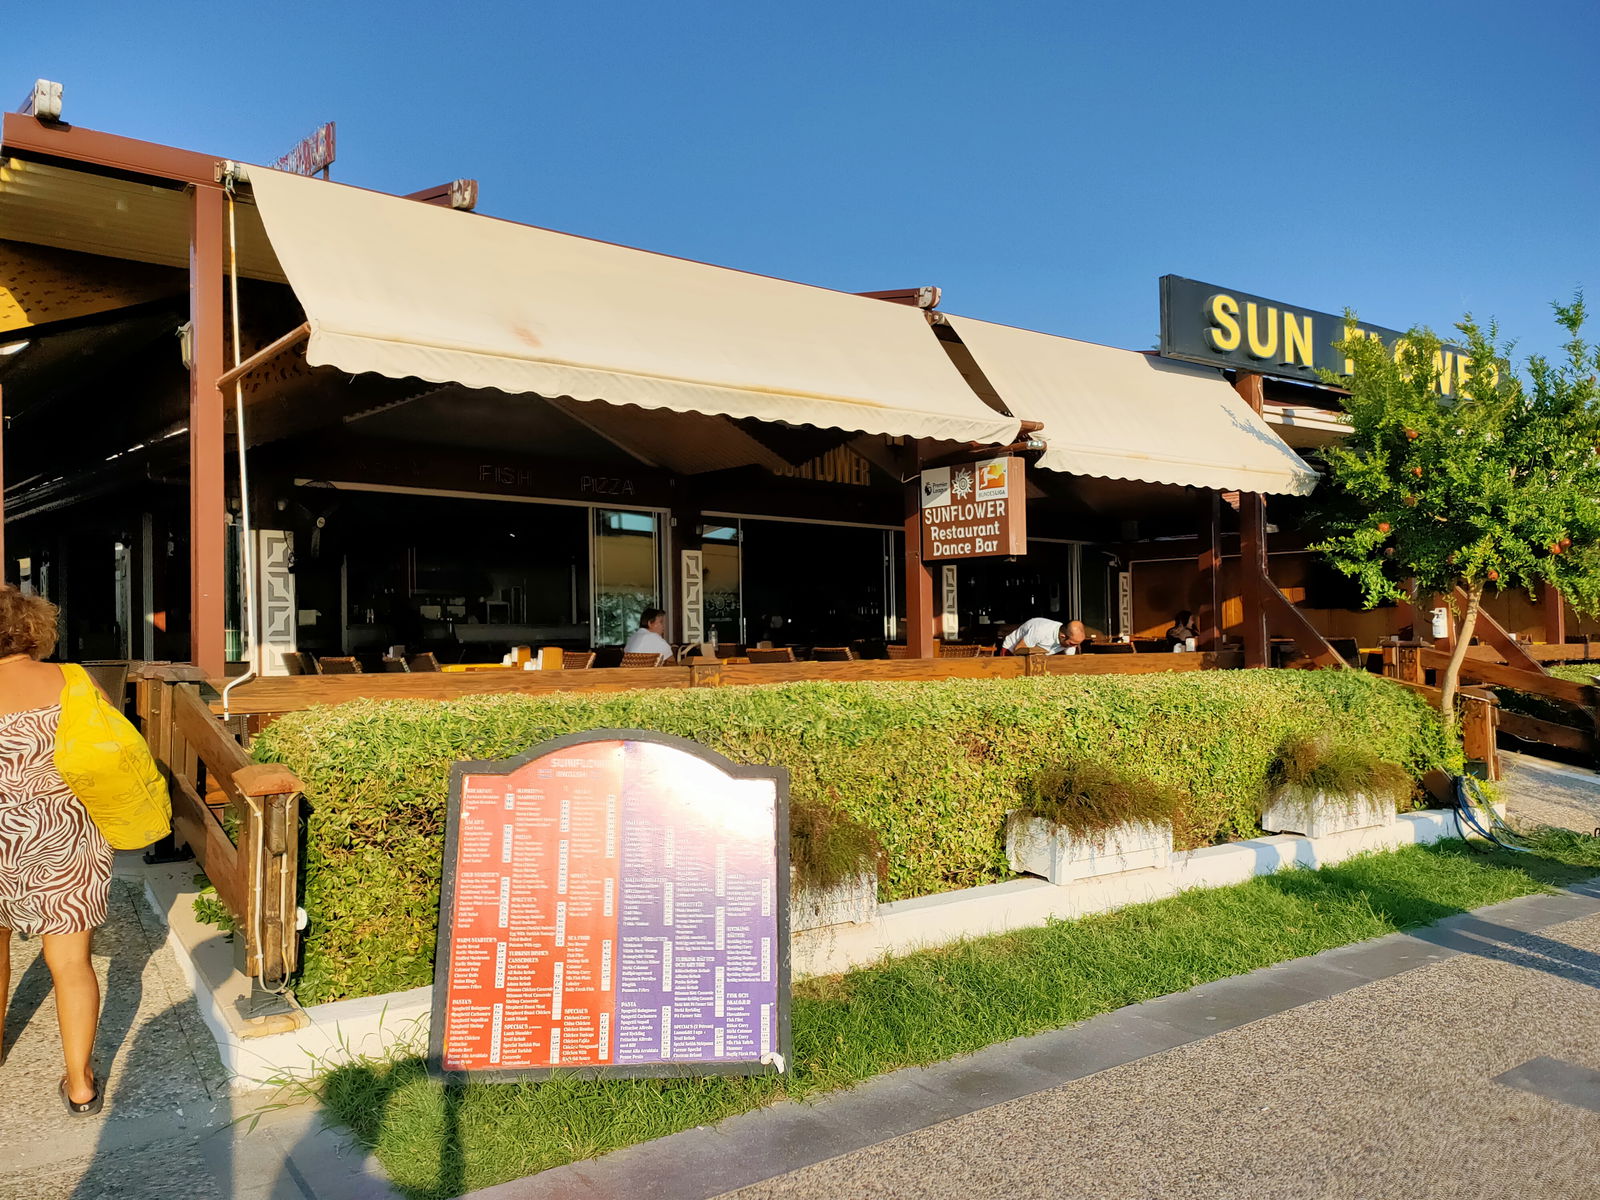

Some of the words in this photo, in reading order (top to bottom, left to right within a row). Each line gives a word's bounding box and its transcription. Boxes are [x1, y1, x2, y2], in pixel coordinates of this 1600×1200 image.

[1211, 293, 1314, 368] SUN
[479, 464, 533, 488] FISH
[580, 475, 636, 496] PIZZA
[925, 500, 1005, 525] SUNFLOWER
[931, 521, 1000, 541] Restaurant
[933, 541, 971, 556] Dance
[975, 538, 998, 553] Bar
